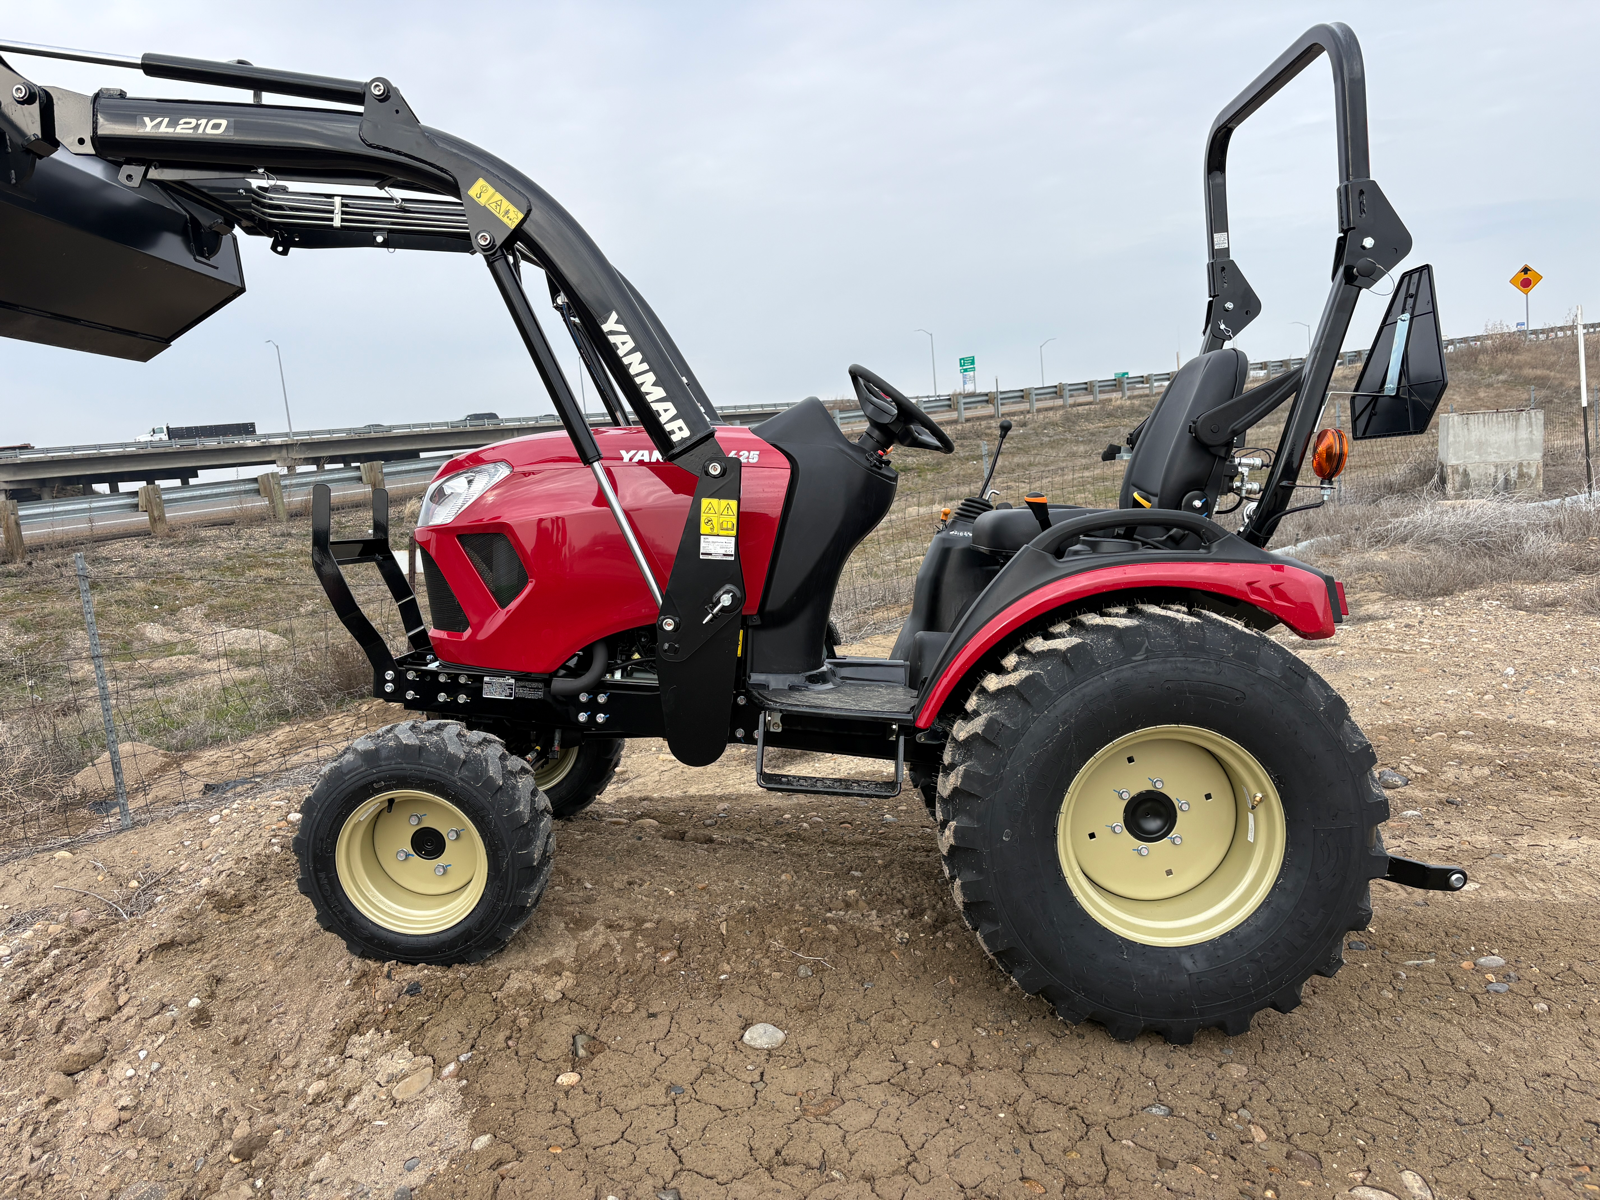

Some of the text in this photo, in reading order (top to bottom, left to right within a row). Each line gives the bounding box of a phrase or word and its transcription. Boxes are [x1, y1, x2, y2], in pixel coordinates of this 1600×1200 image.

[142, 116, 228, 135] YL210
[601, 310, 691, 443] YANMAR
[619, 449, 665, 463] YAN
